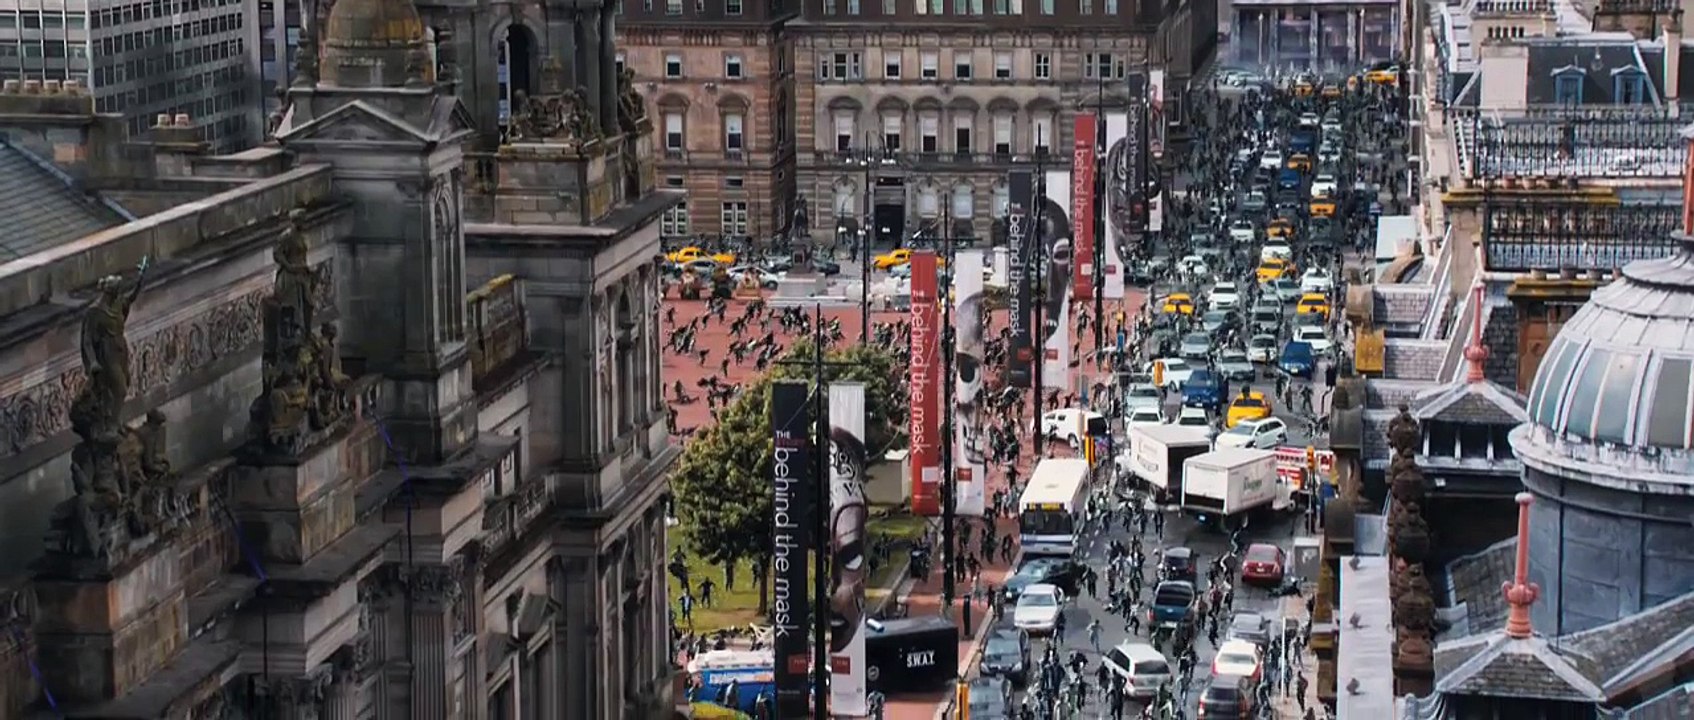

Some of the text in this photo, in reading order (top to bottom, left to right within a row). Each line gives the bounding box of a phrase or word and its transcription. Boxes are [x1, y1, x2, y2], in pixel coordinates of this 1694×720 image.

[1074, 149, 1089, 195] behind
[1074, 198, 1088, 218] the
[1074, 221, 1088, 255] mask
[1009, 213, 1026, 337] behind the mask
[911, 302, 931, 455] behind the mask
[775, 430, 790, 439] THE
[774, 447, 799, 638] behind the mask
